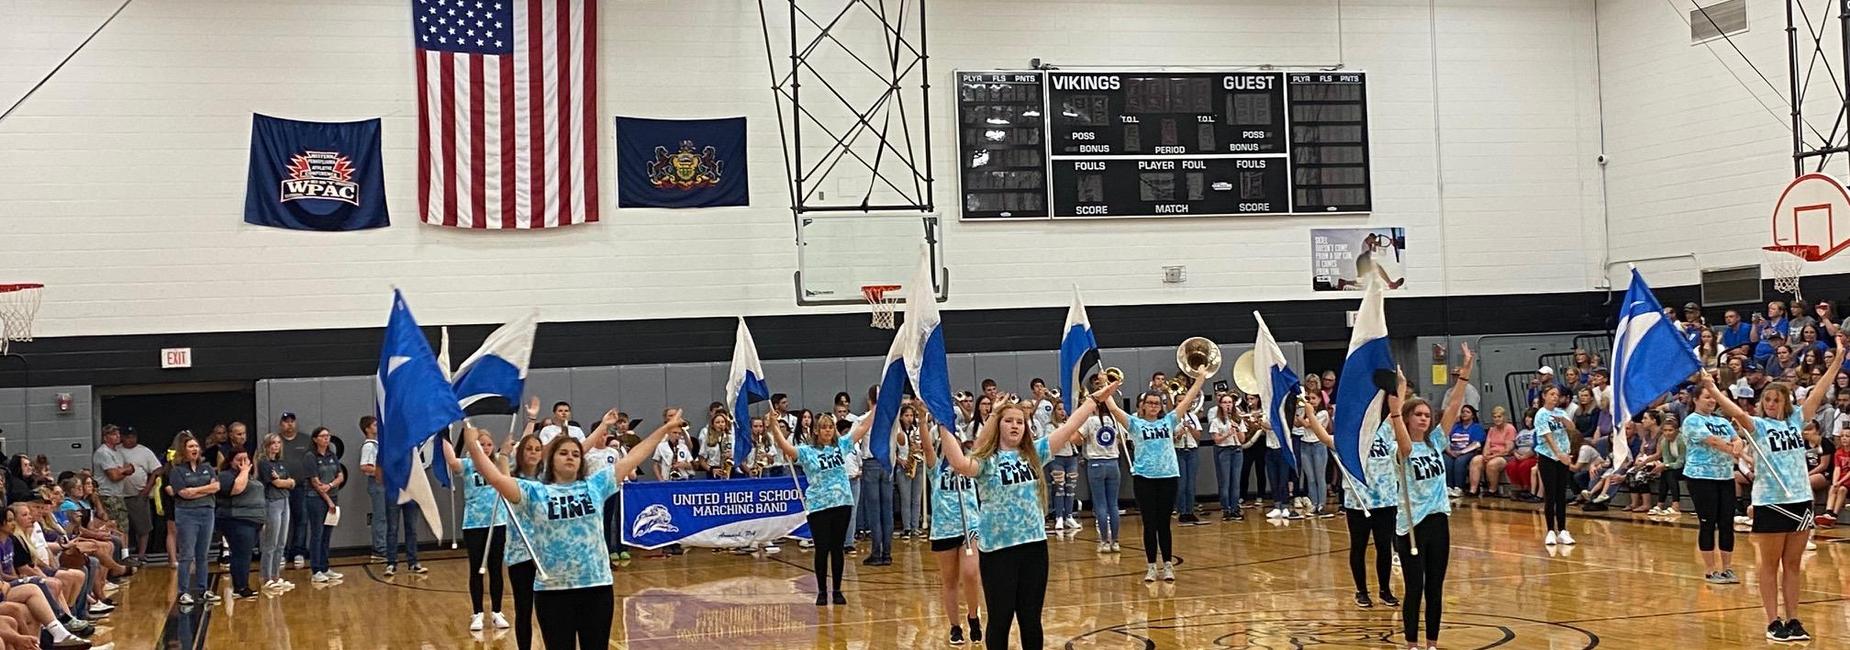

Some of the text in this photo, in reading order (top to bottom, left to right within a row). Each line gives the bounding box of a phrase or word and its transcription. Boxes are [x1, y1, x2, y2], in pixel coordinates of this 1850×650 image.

[1052, 75, 1121, 91] VIKINGS
[1223, 75, 1275, 90] GUEST
[1072, 132, 1095, 140] POSS
[1242, 131, 1265, 139] POSS
[1080, 144, 1110, 152] BONUS
[1155, 146, 1186, 154] PERIOD
[1230, 143, 1259, 151] BONUS
[1075, 162, 1106, 171] FOULS
[1138, 161, 1175, 170] PLAYER
[1182, 161, 1206, 169] FOUL
[1236, 160, 1266, 169] FOULS
[287, 180, 355, 199] WPAC
[1076, 206, 1108, 215] SCORE
[1155, 205, 1189, 213] MATCH
[1239, 203, 1270, 212] SCORE
[167, 352, 186, 365] EXIT
[1769, 434, 1805, 452] LINE
[673, 493, 720, 506] UNITED
[724, 491, 753, 503] HIGH
[547, 498, 596, 520] LINE
[693, 501, 788, 518] MARCHING BAND
